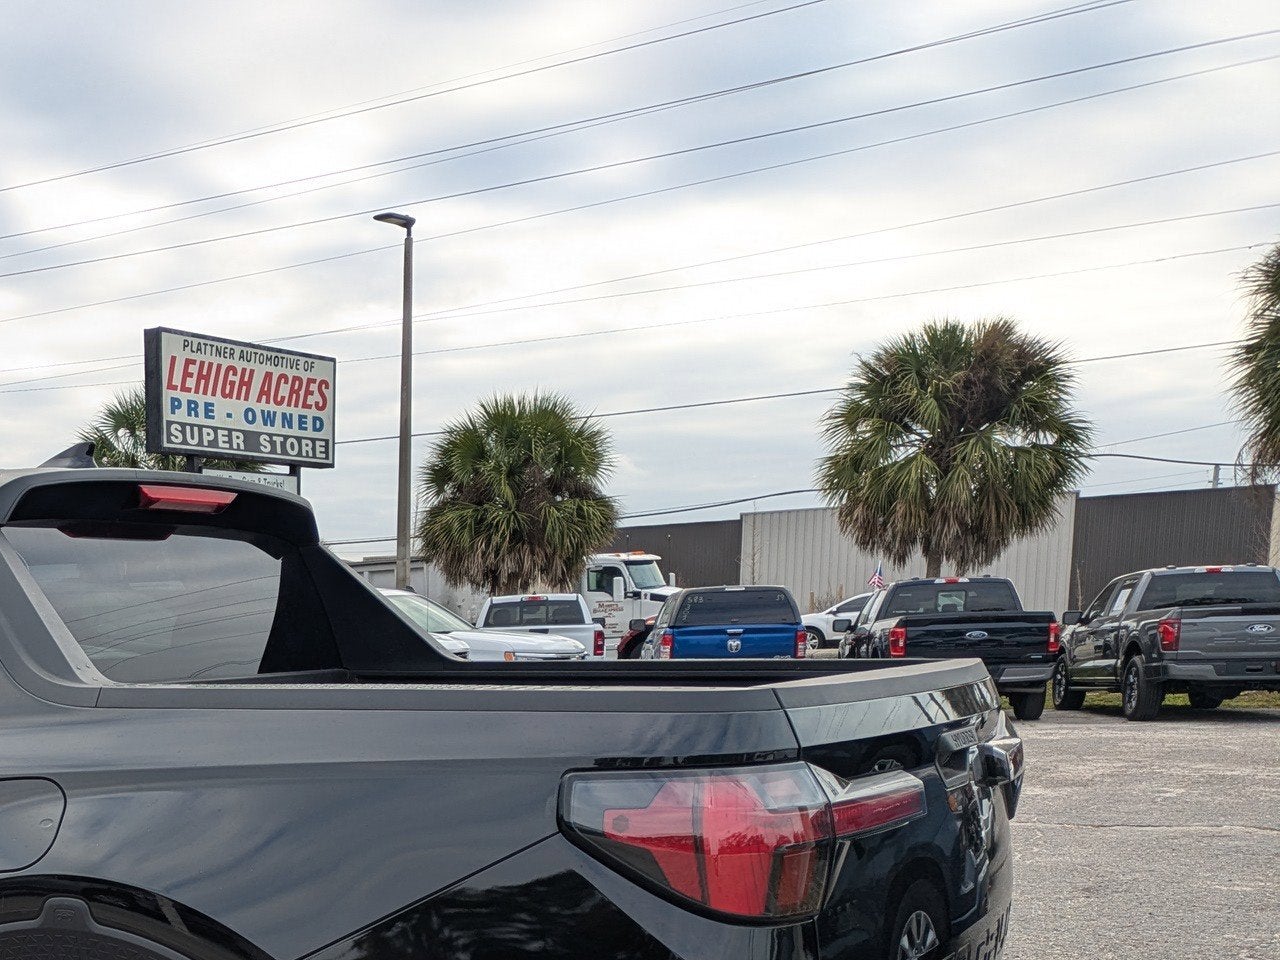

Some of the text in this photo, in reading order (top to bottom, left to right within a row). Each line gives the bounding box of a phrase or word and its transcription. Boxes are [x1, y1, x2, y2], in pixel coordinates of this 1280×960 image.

[182, 338, 316, 373] PLATTNER AUTOMOTIVE OF
[166, 355, 331, 412] LEHIGH ACRES
[170, 396, 216, 421] PRE
[243, 407, 326, 433] OWNED
[170, 424, 328, 459] SUPER STORE
